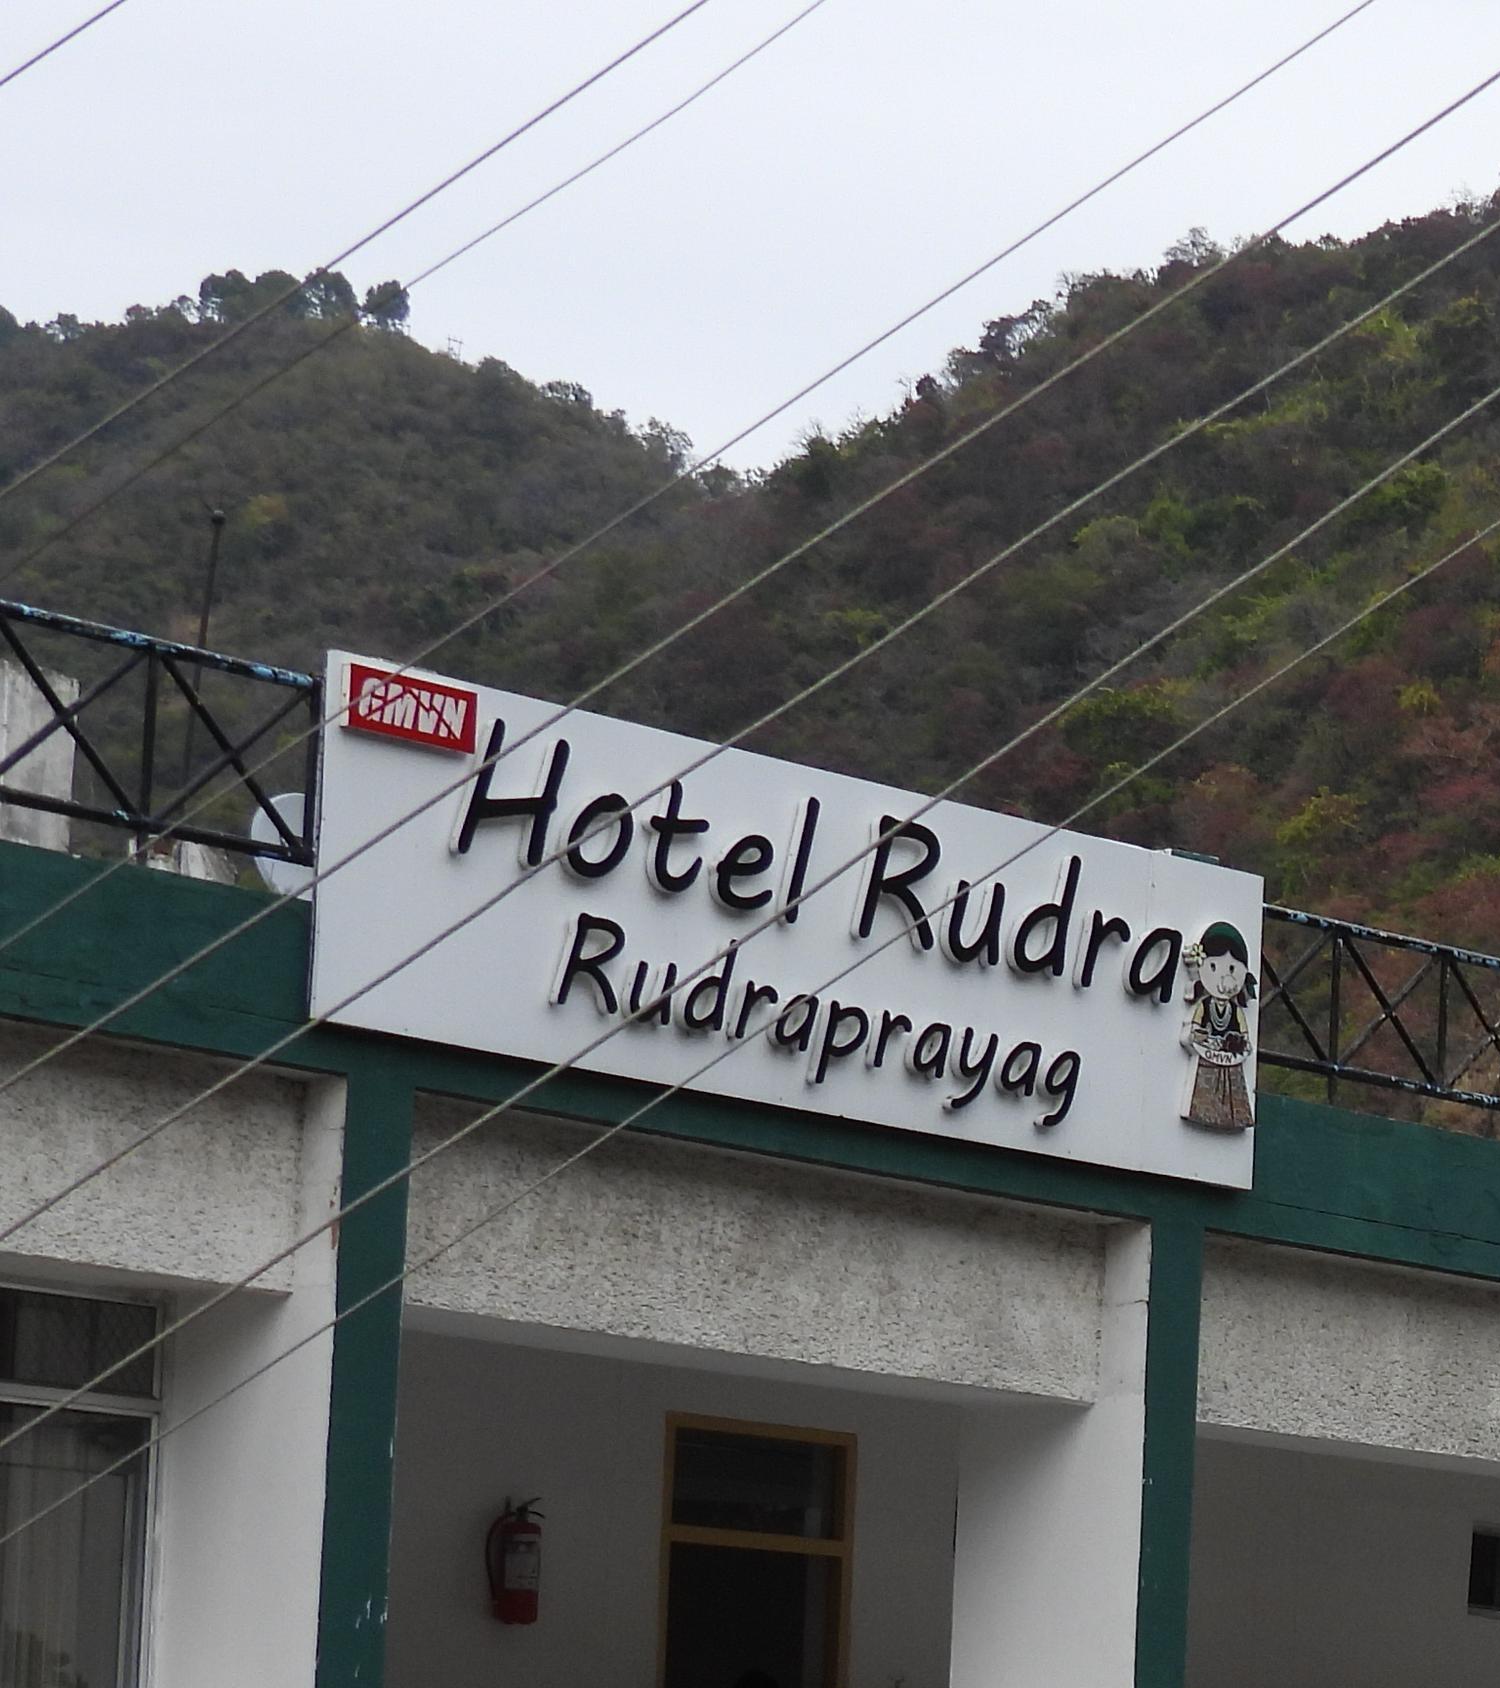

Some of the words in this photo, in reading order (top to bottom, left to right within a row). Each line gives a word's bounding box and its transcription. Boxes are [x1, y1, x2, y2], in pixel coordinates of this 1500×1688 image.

[358, 677, 468, 740] GMVN
[455, 717, 820, 925] Hotel
[856, 814, 1184, 1013] Rudra
[555, 912, 1082, 1128] Rudraprayag
